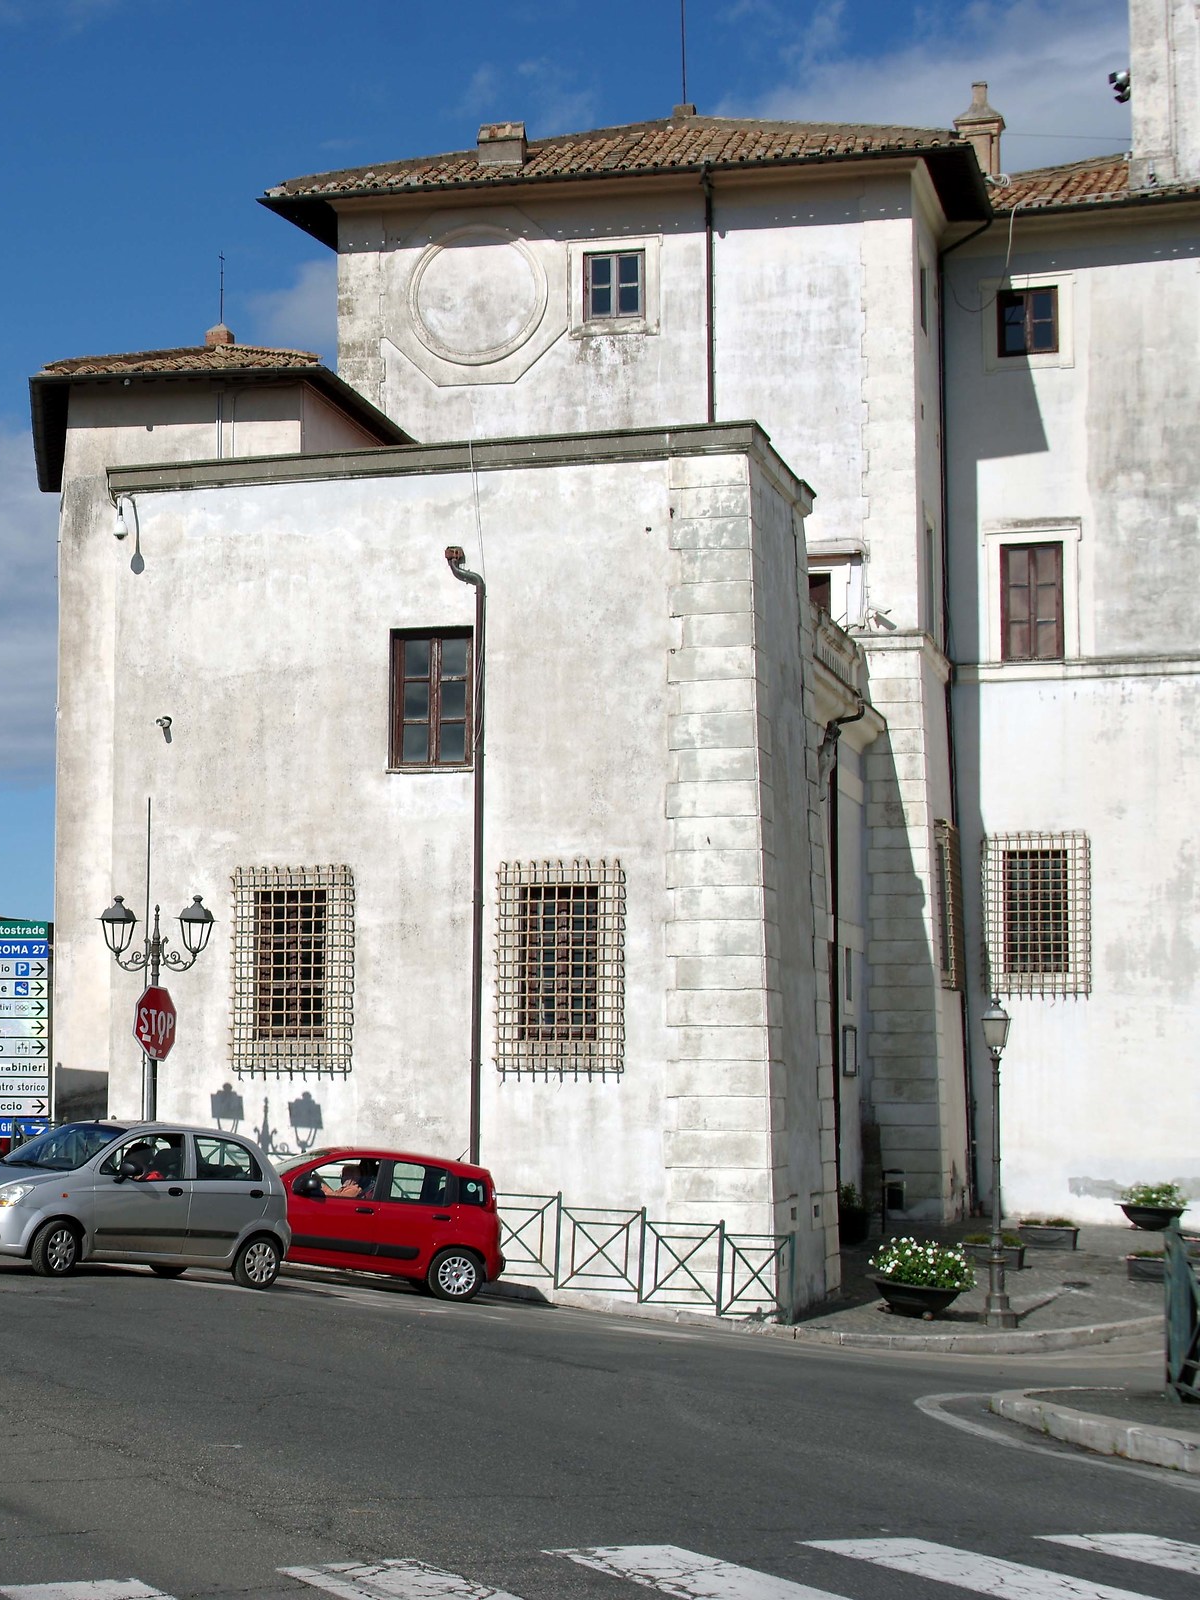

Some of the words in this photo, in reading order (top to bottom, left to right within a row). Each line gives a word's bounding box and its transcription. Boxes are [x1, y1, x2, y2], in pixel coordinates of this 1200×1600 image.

[32, 945, 45, 954] 27
[139, 1007, 174, 1039] STOP
[17, 1082, 46, 1091] storico
